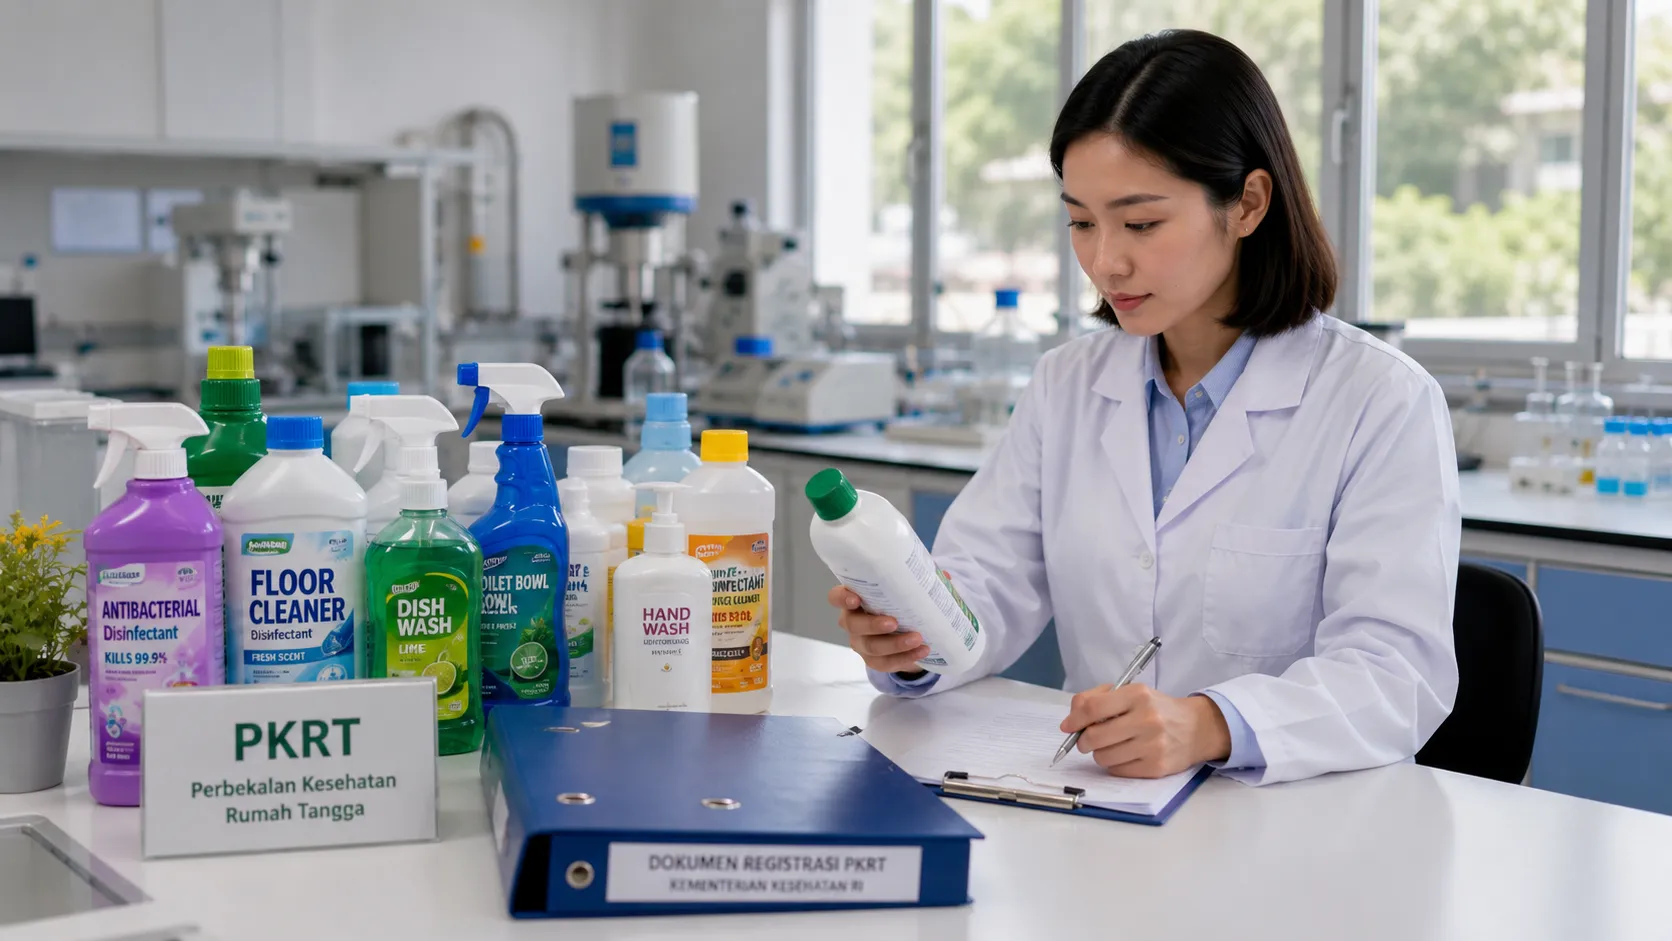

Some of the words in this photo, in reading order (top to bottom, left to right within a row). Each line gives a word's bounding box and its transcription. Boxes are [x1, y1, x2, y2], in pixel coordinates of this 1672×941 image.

[251, 568, 334, 596] FLOOR
[482, 575, 513, 591] OILET
[515, 573, 550, 590] BOWL
[102, 599, 201, 619] ANTIBACTERIAL
[250, 597, 345, 624] CLEANER
[397, 597, 445, 617] DISH
[642, 607, 691, 621] HAND
[103, 625, 178, 641] Disinfectant
[251, 628, 313, 641] Disinfectant
[397, 616, 452, 637] WASH
[642, 622, 690, 635] WASH
[104, 651, 132, 665] KILLS
[135, 651, 168, 665] 99.9%
[251, 652, 276, 663] FRESH
[278, 651, 306, 662] SCENT
[399, 643, 427, 655] LIME
[234, 717, 361, 761] PKRT
[191, 777, 296, 798] Perbekalan
[302, 773, 397, 793] Kesehatan
[226, 804, 292, 823] Rumah
[298, 802, 364, 821] Tangga
[649, 854, 738, 872] DOKUMEN
[743, 855, 839, 872] REGISTRASI
[845, 856, 887, 873] PKRT
[669, 878, 767, 893] KEMENTERIAN
[771, 879, 847, 893] KESEHATAN
